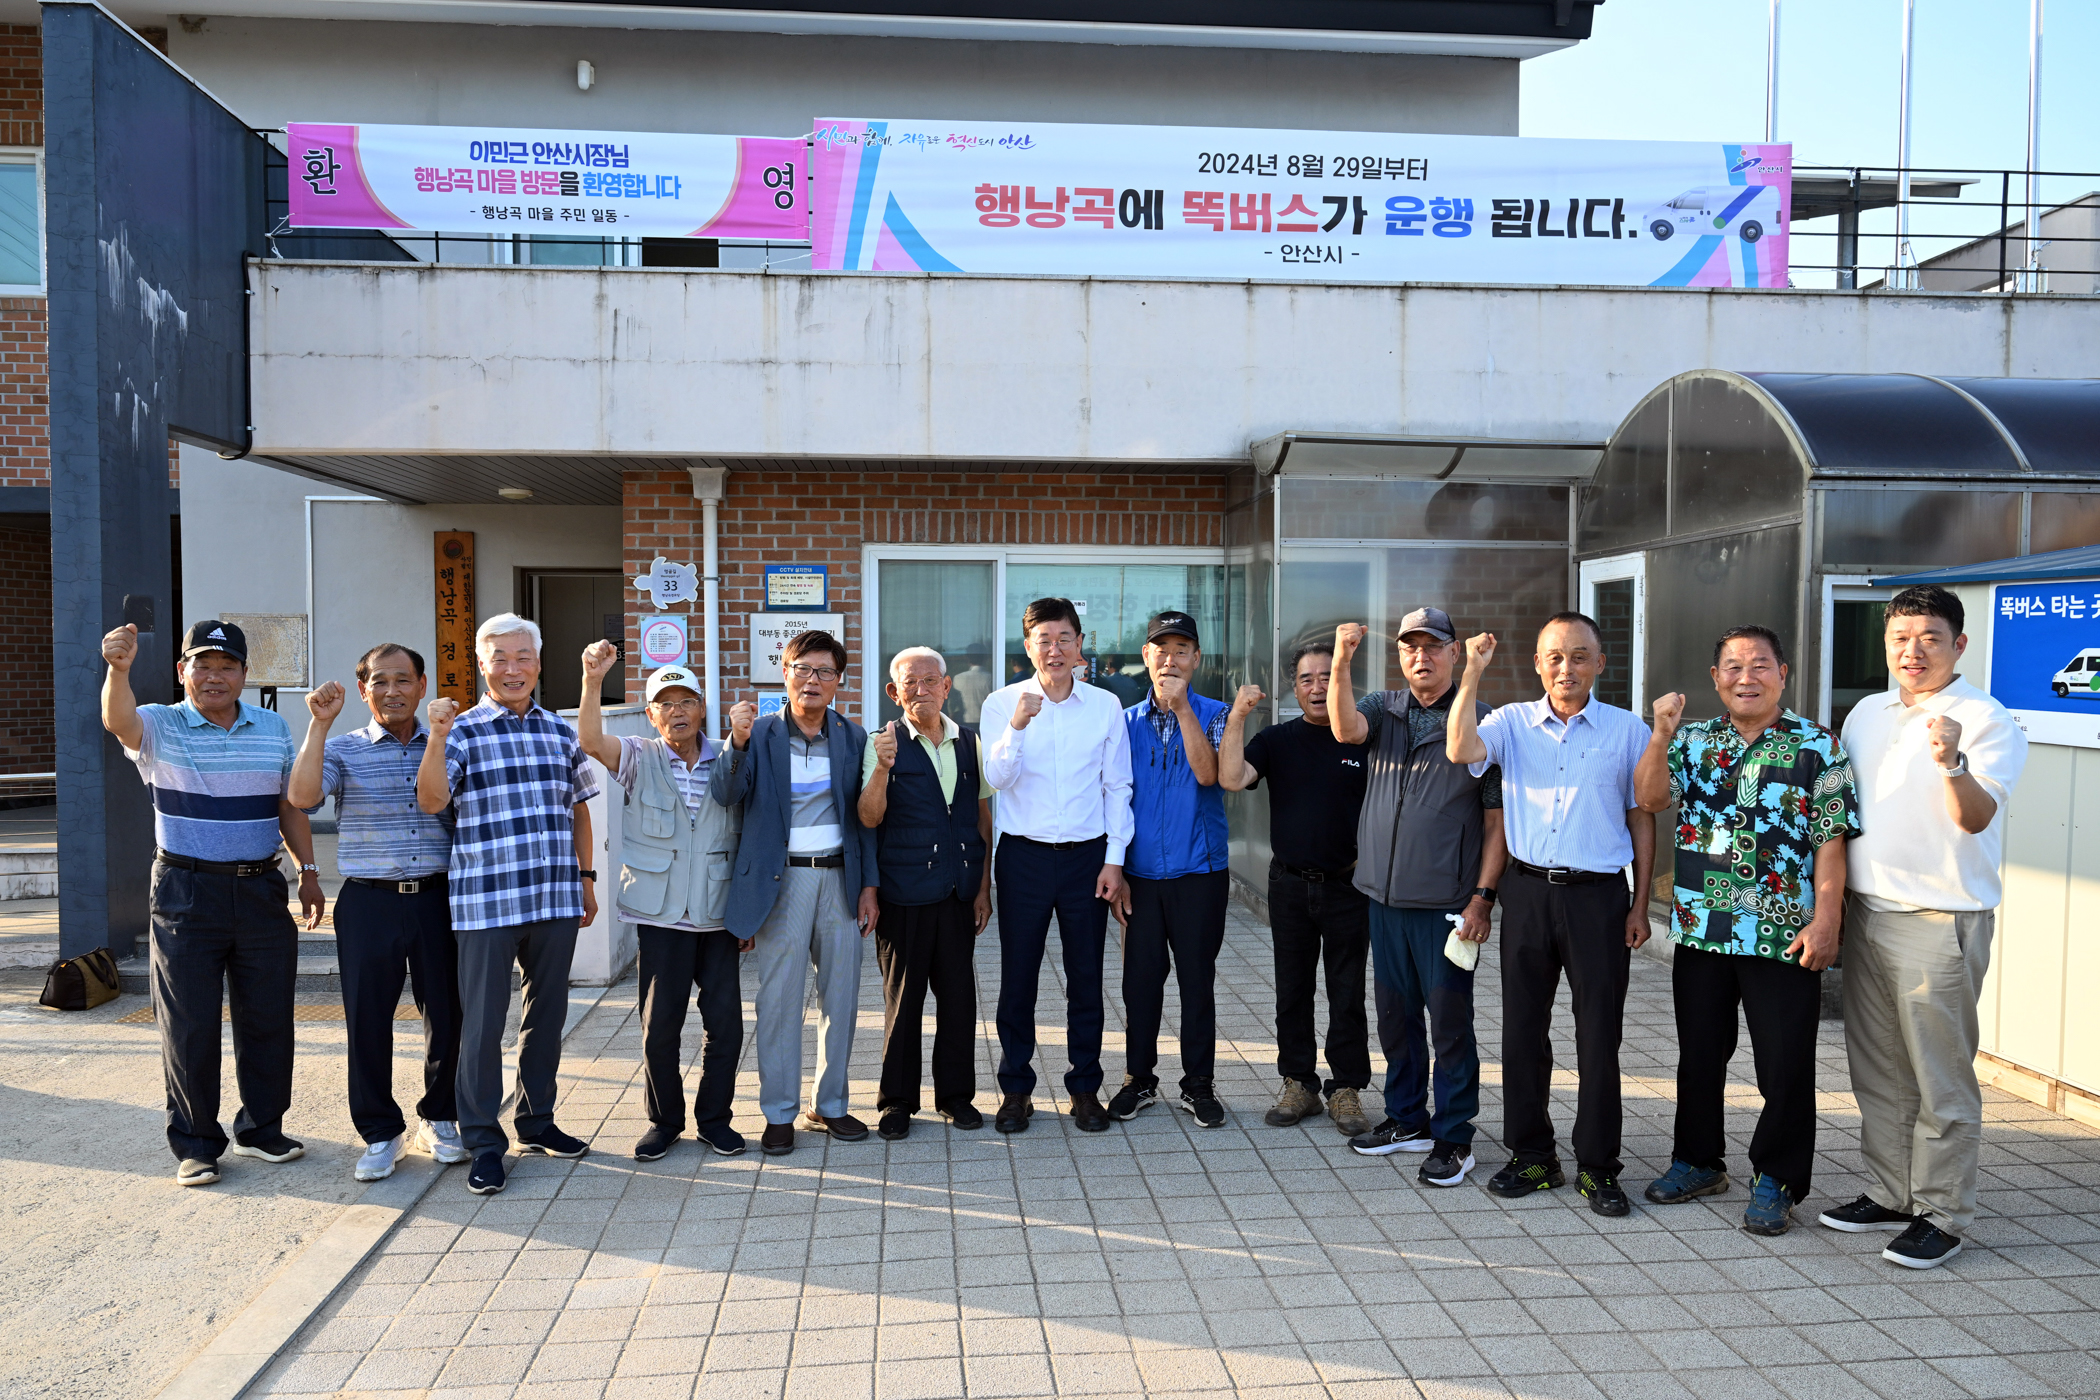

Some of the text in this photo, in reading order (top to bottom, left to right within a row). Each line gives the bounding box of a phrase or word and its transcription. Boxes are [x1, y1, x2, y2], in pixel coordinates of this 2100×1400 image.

[816, 125, 859, 151] 시민과
[898, 133, 941, 152] 자유로운
[946, 133, 994, 152] 혁신도시
[998, 133, 1037, 150] 안산
[469, 141, 629, 168] 이민근 안산시장님
[1198, 152, 1428, 181] 2024년 8월 29일부터
[302, 147, 341, 195] 환
[414, 167, 682, 200] 행낭곡 마을 방문을 환영합니다
[763, 162, 795, 210] 영
[482, 205, 521, 221] 행낭곡
[528, 206, 554, 222] 마을
[560, 207, 586, 223] 주민
[593, 207, 618, 224] 일동
[974, 182, 1638, 240] 행낭곡에 똑버스가 운행 됩니다.
[1280, 244, 1343, 265] 안산시
[440, 567, 458, 626] 행낭곡
[664, 581, 677, 591] 33
[2001, 596, 2046, 620] 똑버스
[2051, 595, 2086, 619] 타는
[759, 630, 780, 638] 대부동
[785, 621, 808, 629] 2015년
[1341, 758, 1360, 767] FILA
